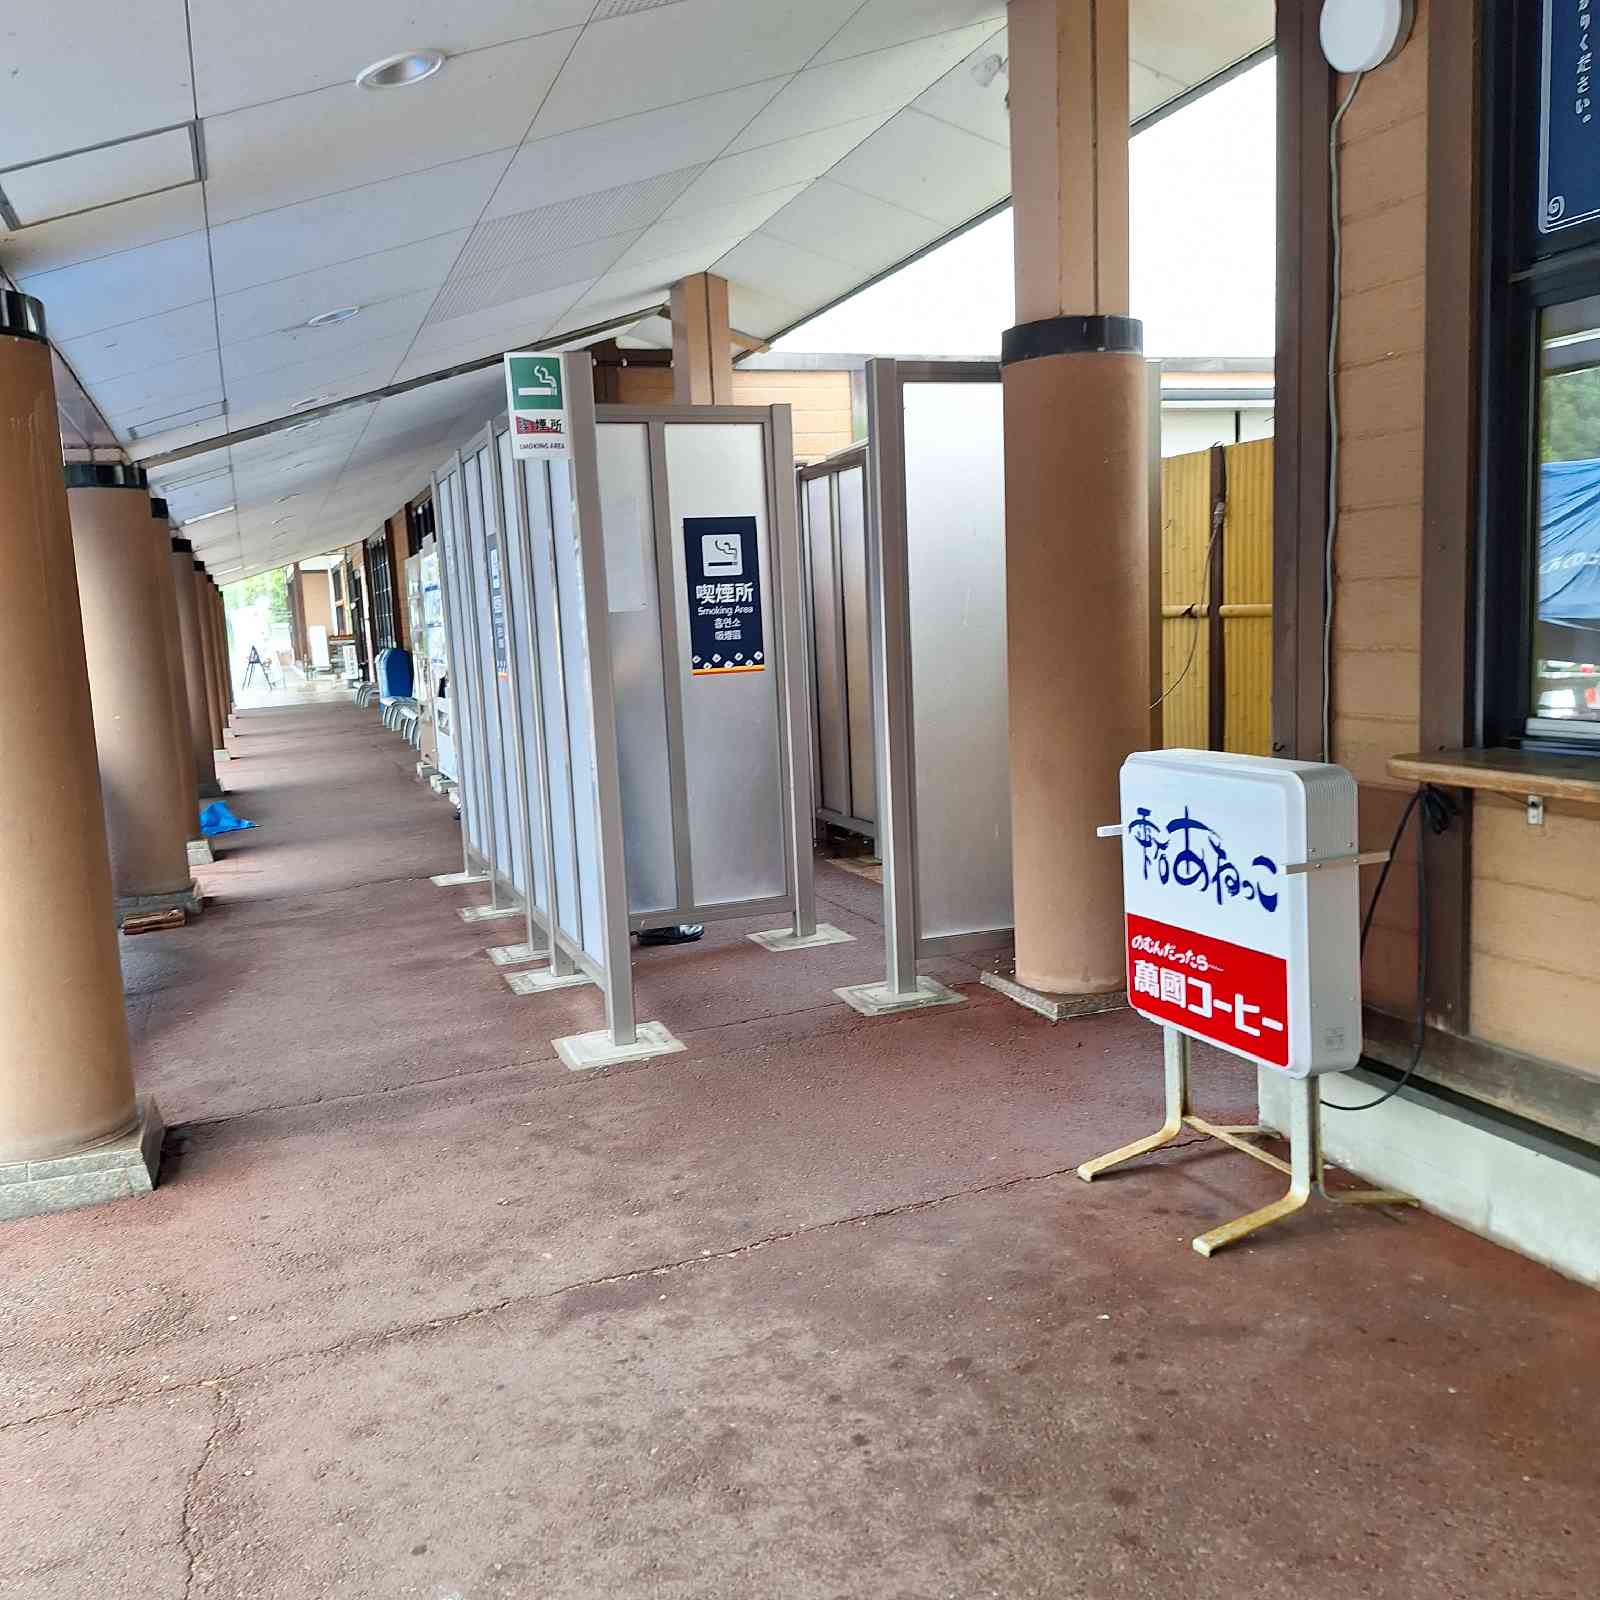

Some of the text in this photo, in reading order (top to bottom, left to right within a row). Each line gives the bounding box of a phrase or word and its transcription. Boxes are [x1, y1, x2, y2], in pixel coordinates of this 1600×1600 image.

[695, 582, 754, 604] 喫煙所
[697, 605, 754, 617] Smoking Area
[1134, 959, 1284, 1037] 萬國コーヒー
